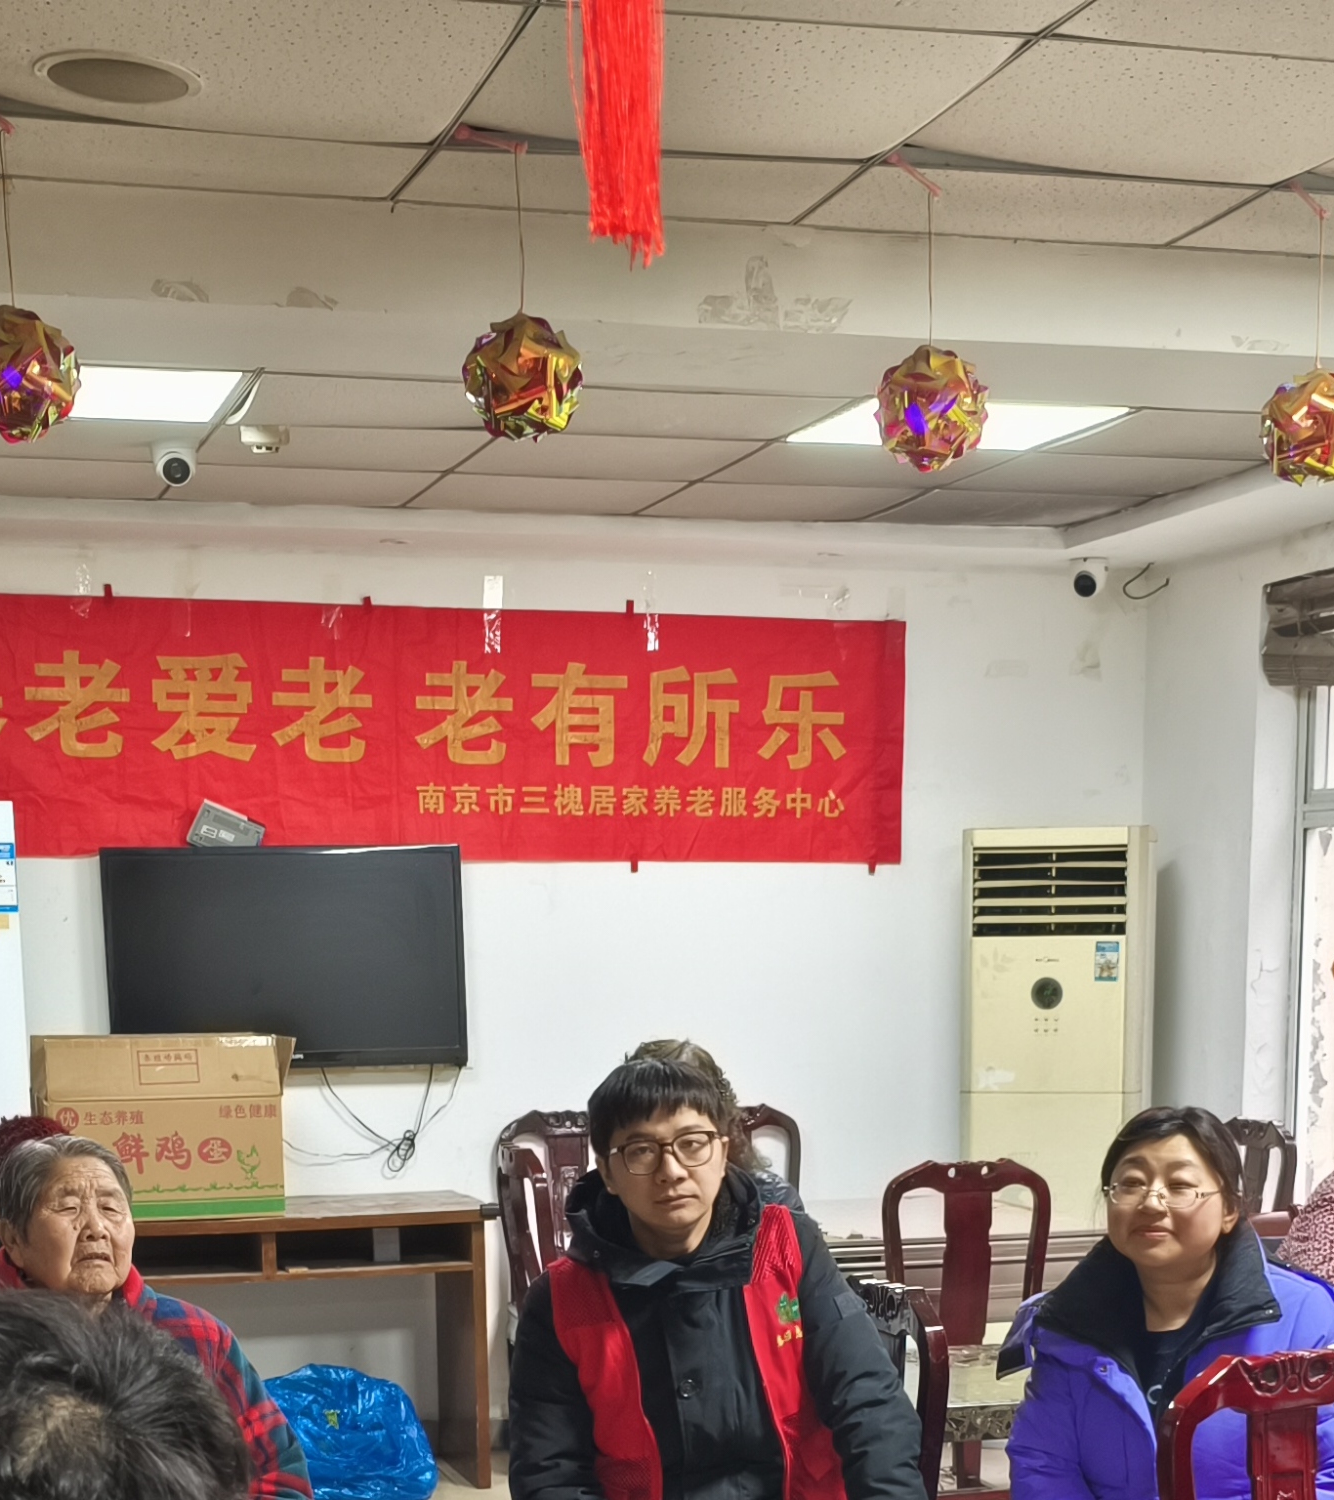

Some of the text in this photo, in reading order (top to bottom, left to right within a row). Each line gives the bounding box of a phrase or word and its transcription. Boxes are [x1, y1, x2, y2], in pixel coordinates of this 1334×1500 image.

[414, 660, 846, 770] 老有所乐
[416, 782, 845, 818] 南京市三槐居家养老服务中心
[83, 1110, 145, 1126] 生态养殖
[219, 1104, 277, 1119] 绿色健康
